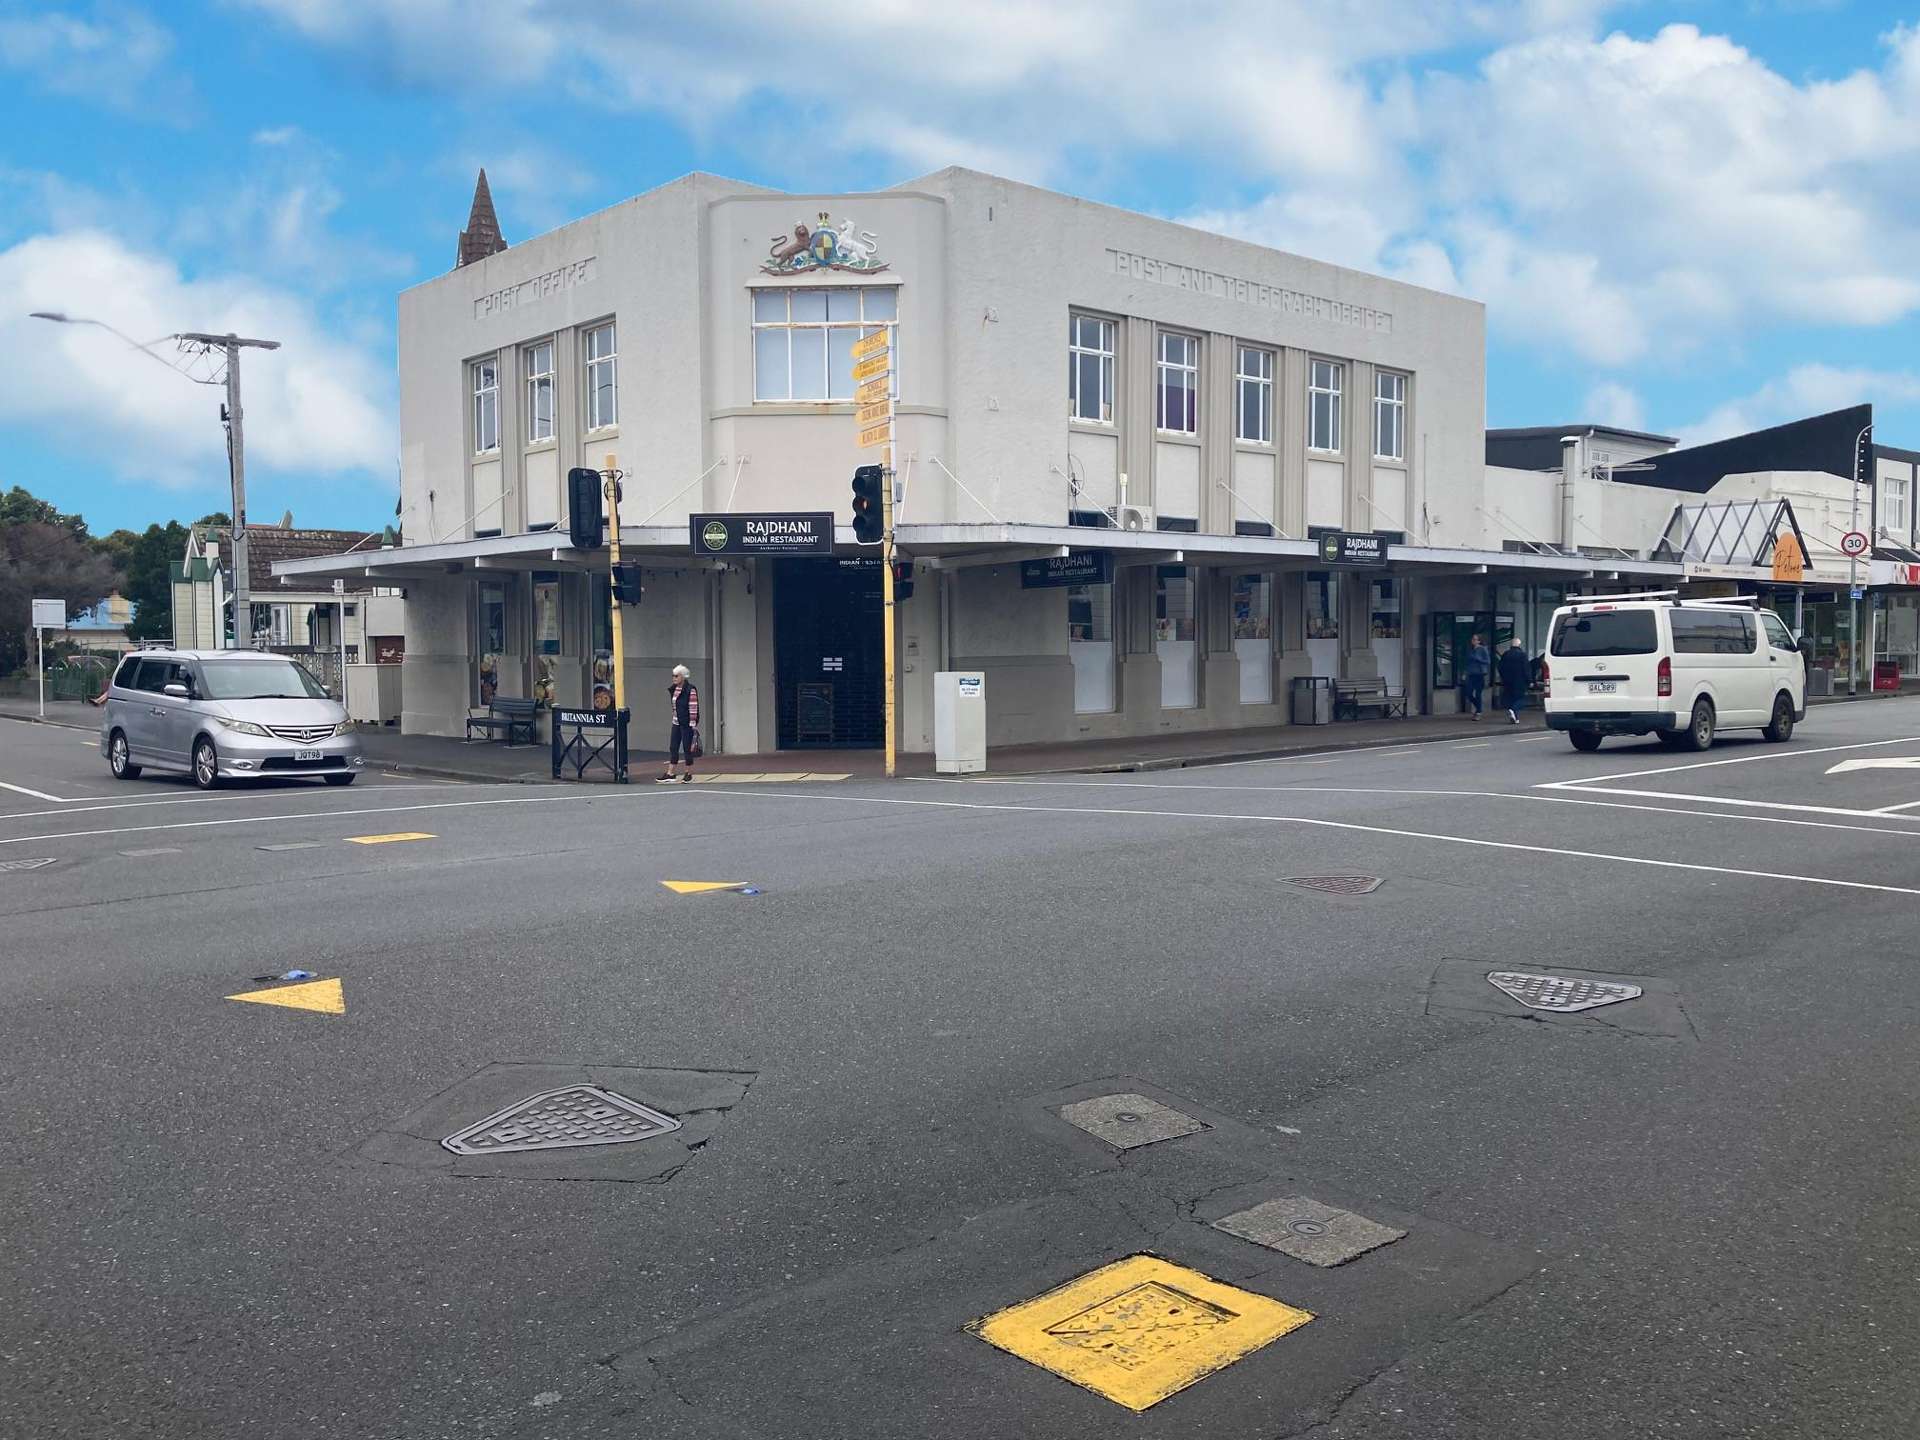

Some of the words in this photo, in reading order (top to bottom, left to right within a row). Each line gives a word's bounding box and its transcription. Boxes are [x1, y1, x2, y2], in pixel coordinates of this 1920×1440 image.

[1115, 251, 1169, 285] POST
[1179, 266, 1216, 294] AND
[1223, 276, 1322, 321] TELEGRAPH
[1329, 300, 1387, 334] OFFICE
[746, 521, 811, 535] RAJDHANI
[742, 535, 768, 543] INDIAN
[770, 535, 819, 543] RESTAURANT
[1346, 538, 1378, 549] RAJDHANI
[1847, 539, 1861, 548] 30
[1049, 554, 1093, 570] RAJDHANI
[561, 712, 595, 723] BRITANNIA
[595, 714, 607, 724] ST
